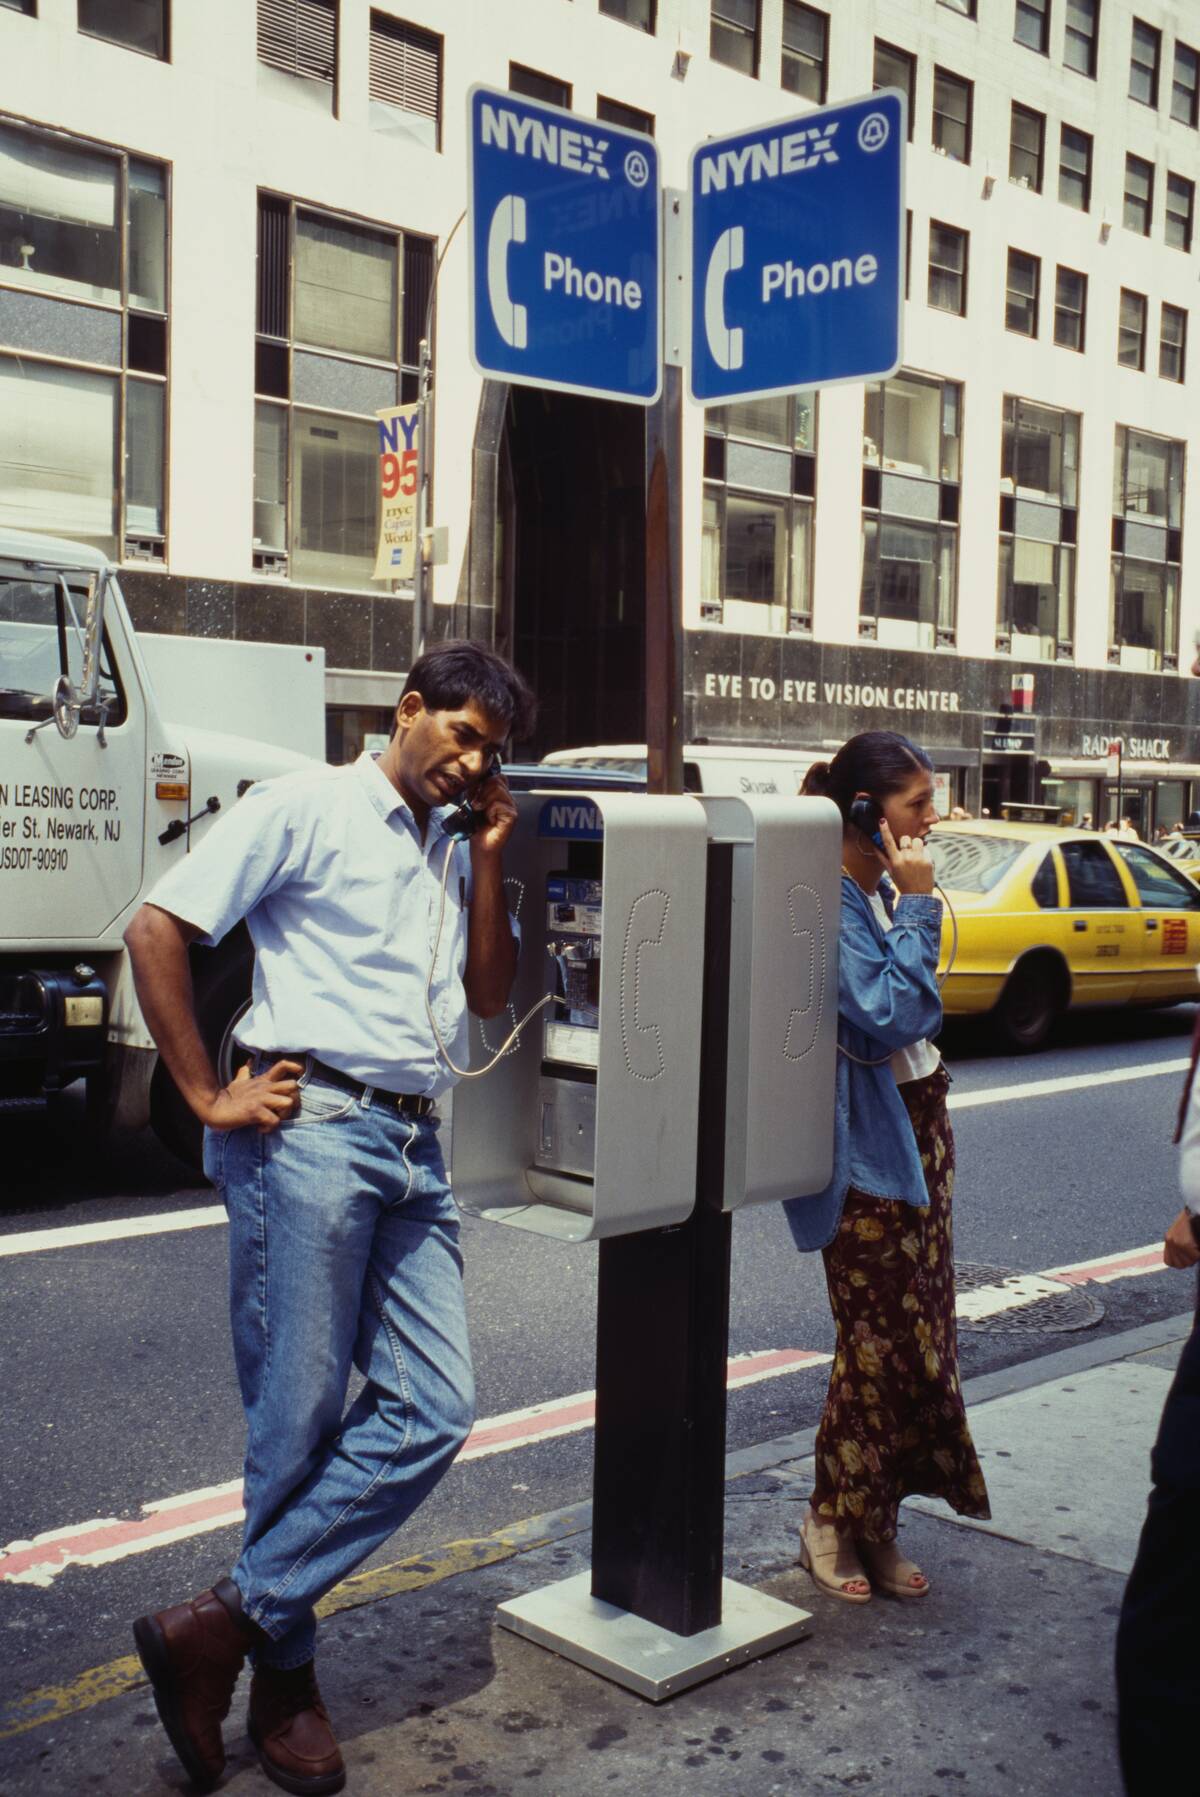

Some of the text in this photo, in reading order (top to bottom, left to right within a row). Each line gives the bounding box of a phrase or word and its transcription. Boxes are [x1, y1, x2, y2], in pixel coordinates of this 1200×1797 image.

[480, 103, 611, 180] NYNEX
[700, 121, 840, 196] NYNEX
[543, 251, 643, 310] Phone
[761, 253, 879, 303] Phone
[378, 414, 419, 455] NY
[381, 449, 418, 499] 95
[705, 673, 960, 713] EYE TO EYE VISION CENTER
[1129, 737, 1171, 759] SHACK
[15, 785, 74, 810] LEASING
[80, 787, 119, 812] CORP.
[22, 816, 41, 839] St.
[47, 817, 99, 845] Newark,
[104, 819, 121, 842] NJ
